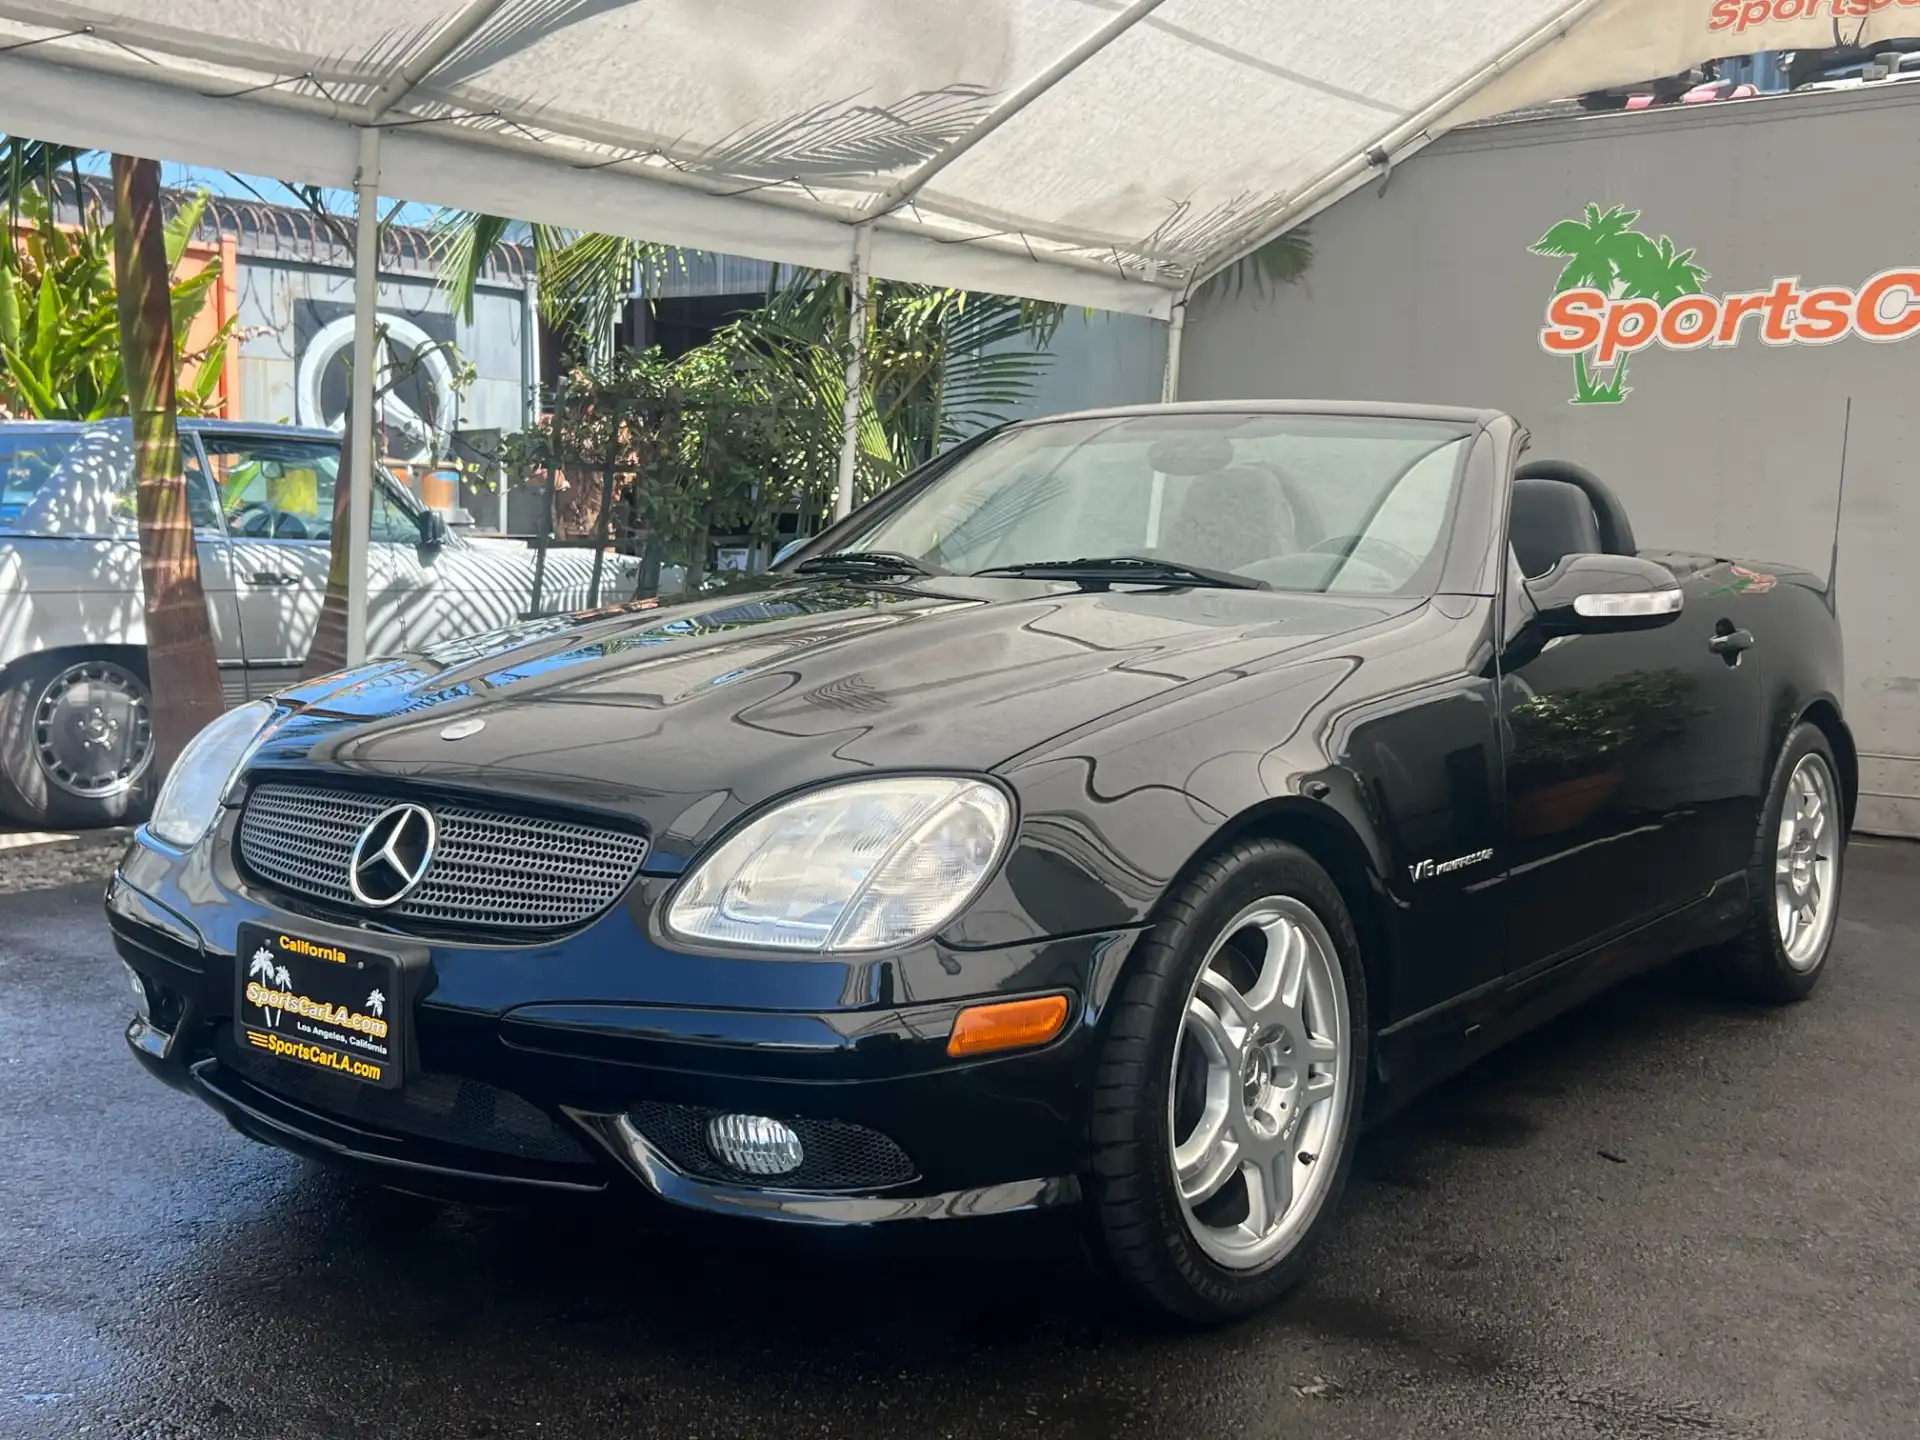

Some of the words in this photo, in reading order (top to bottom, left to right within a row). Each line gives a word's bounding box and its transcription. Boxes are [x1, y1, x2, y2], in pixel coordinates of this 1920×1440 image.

[1541, 267, 1920, 366] SportsC
[1408, 859, 1434, 883] V6
[279, 935, 346, 963] California
[246, 982, 388, 1038] SportsCarLA.com
[268, 1035, 381, 1081] SportsCarLA.com
[297, 1021, 312, 1033] Los
[312, 1027, 348, 1044] Angeles,
[349, 1036, 388, 1055] California
